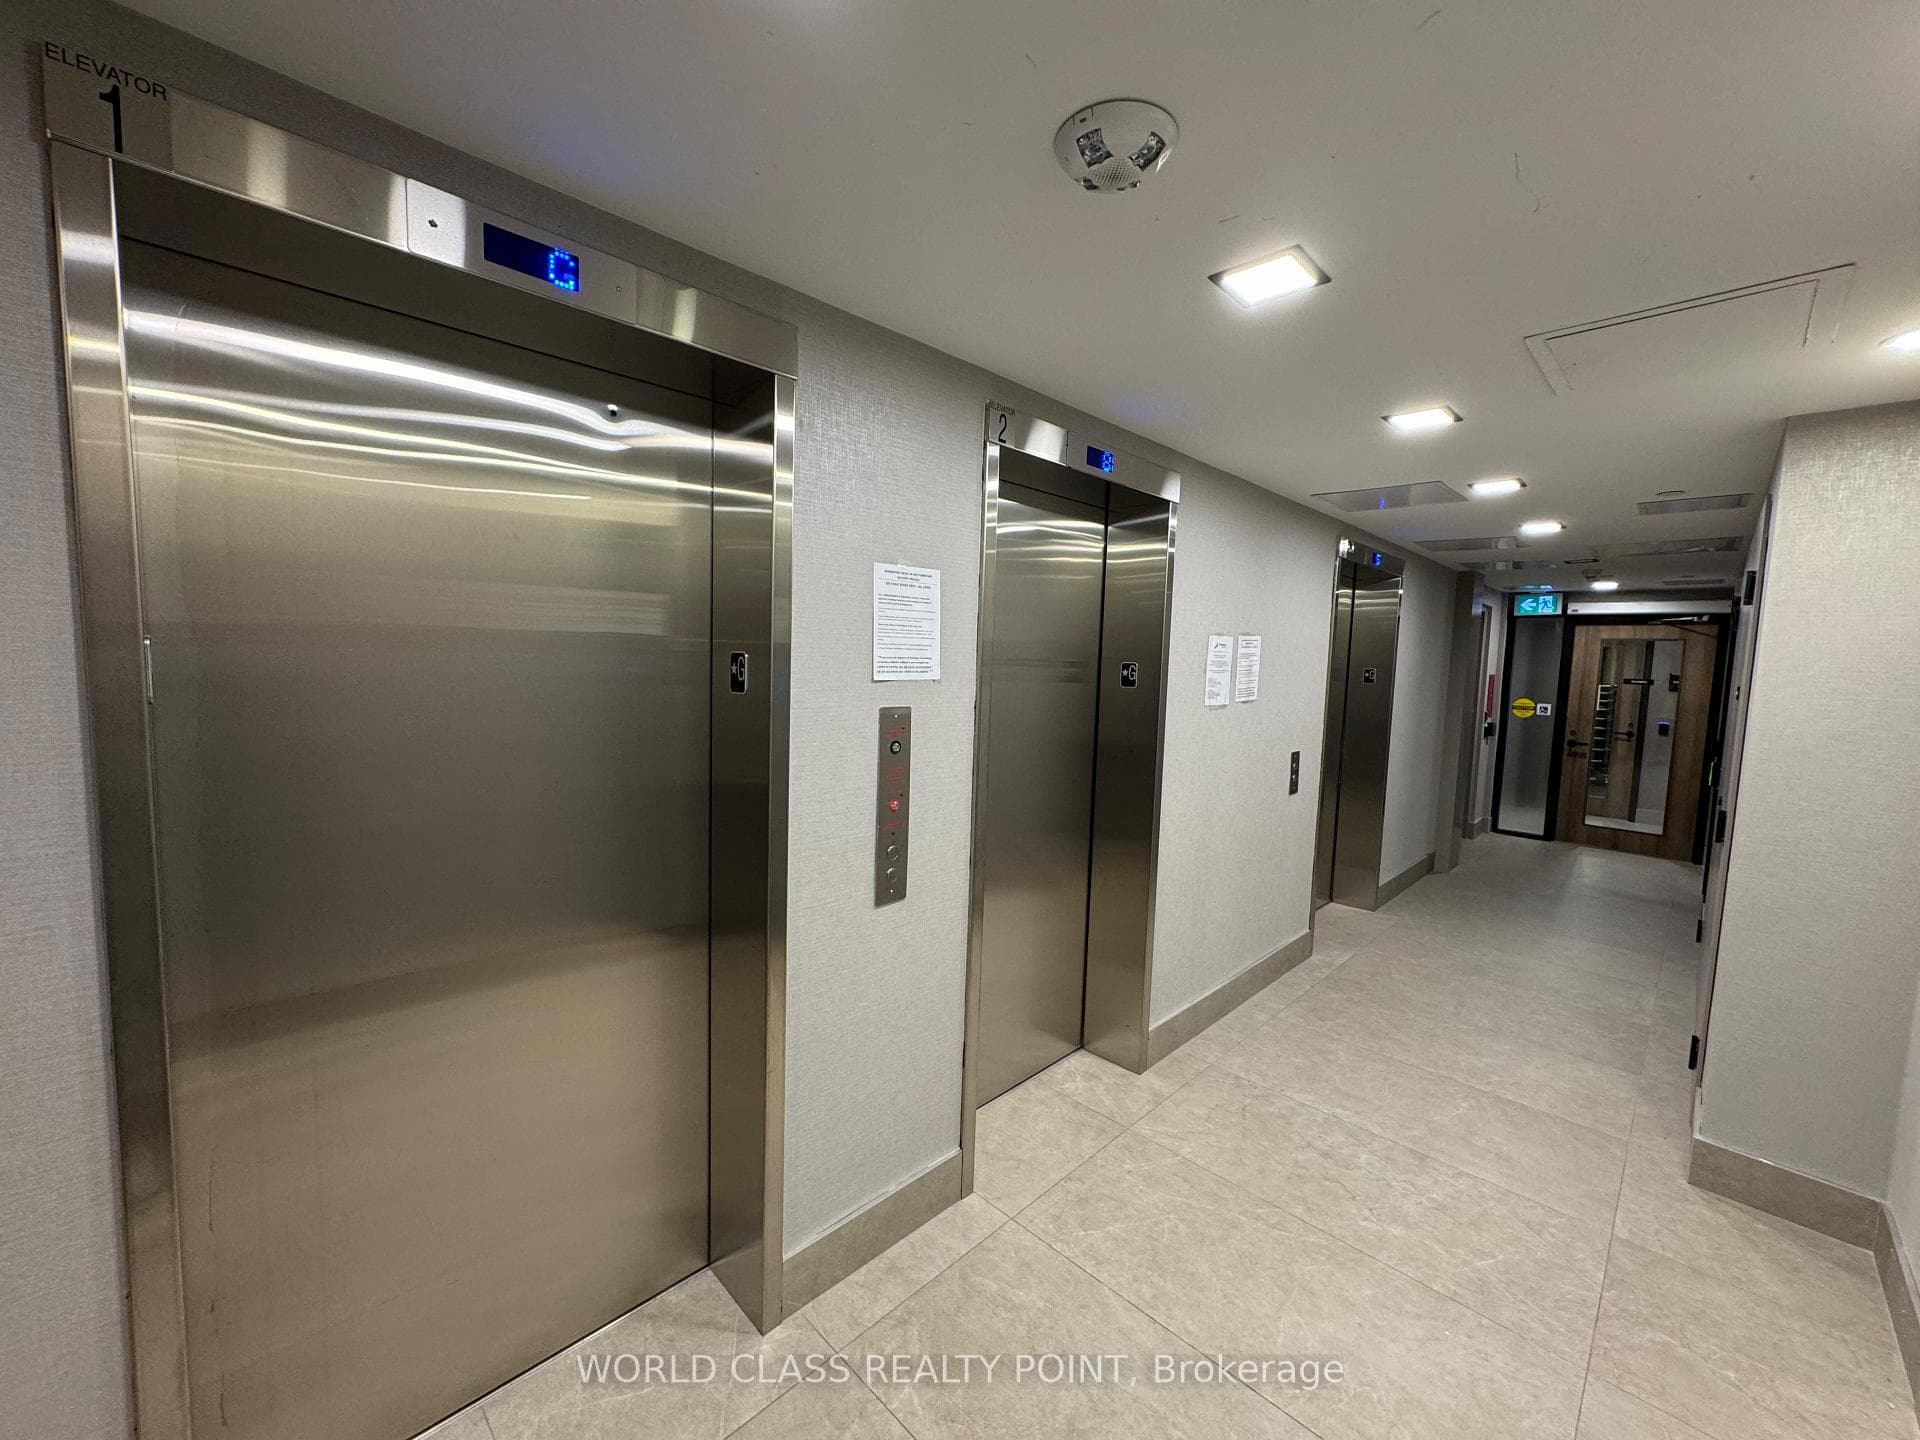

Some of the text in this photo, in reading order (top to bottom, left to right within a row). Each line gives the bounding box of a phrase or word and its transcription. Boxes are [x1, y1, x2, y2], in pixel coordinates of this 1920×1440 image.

[45, 41, 168, 101] ELEVATOR
[99, 84, 123, 154] 1
[990, 402, 1016, 417] ELEVATOR
[998, 413, 1007, 444] 2
[737, 656, 745, 681] G
[1128, 665, 1136, 680] G
